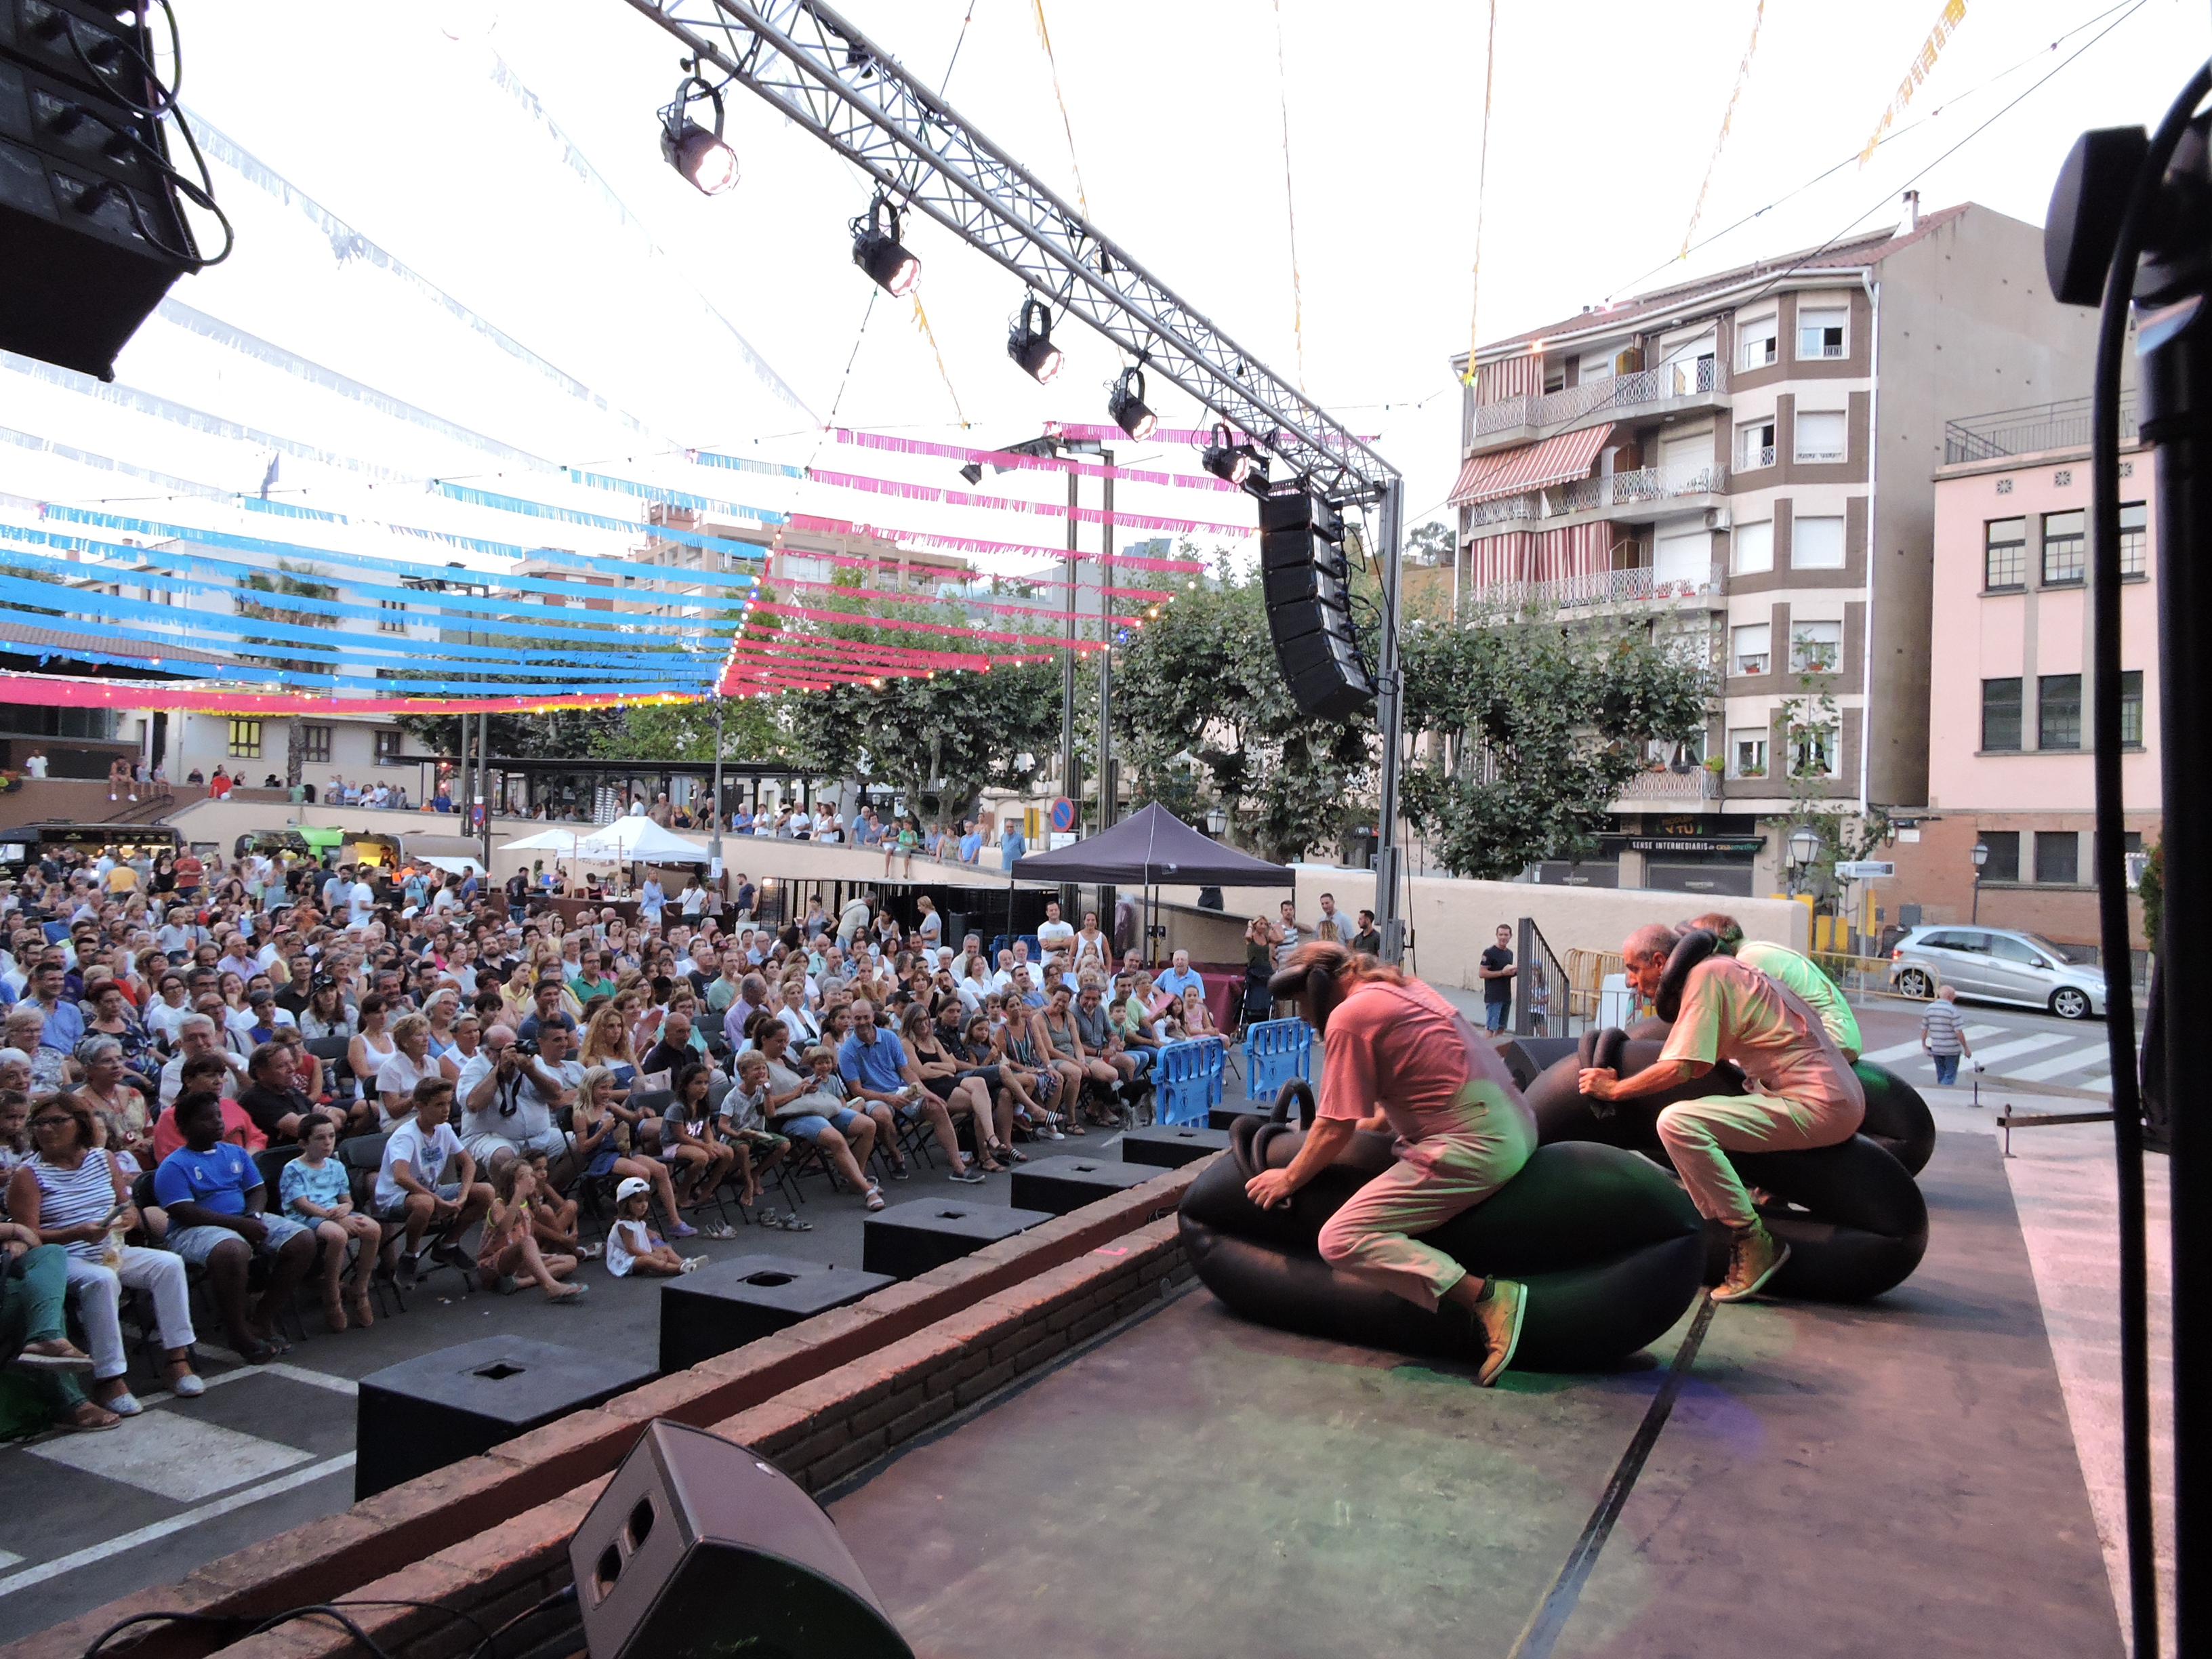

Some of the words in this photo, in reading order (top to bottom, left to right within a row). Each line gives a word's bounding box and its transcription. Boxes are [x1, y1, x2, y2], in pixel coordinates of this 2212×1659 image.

[1632, 841, 1652, 849] SENSE
[1656, 841, 1707, 851] INTERMEDIARIS
[194, 1166, 203, 1181] 6
